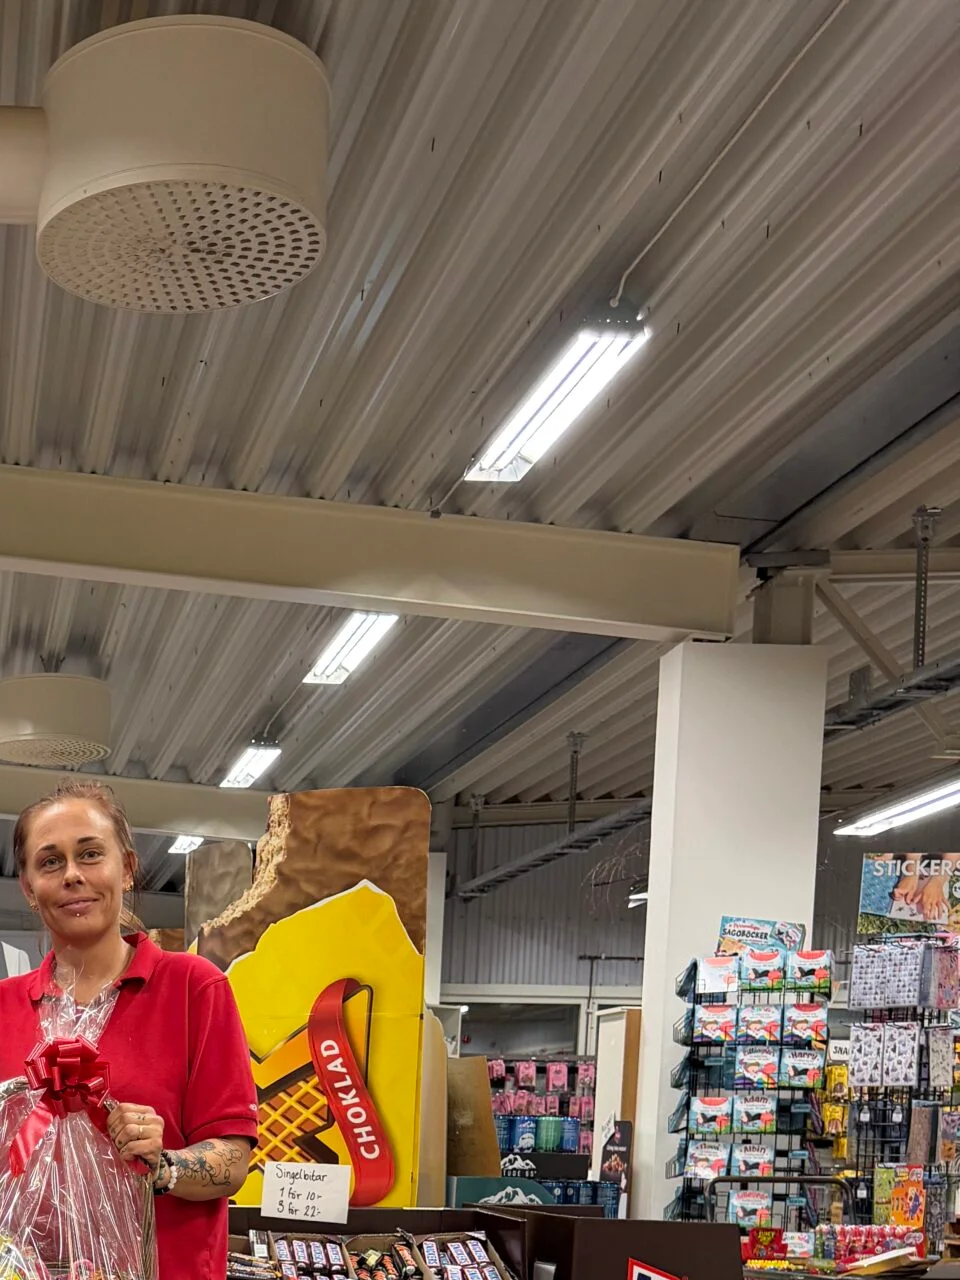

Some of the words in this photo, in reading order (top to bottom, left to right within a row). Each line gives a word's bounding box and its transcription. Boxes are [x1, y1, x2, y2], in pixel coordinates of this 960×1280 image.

[721, 928, 769, 941] SAGOBÖCKER
[790, 1051, 818, 1060] Harry
[320, 1039, 381, 1161] CHOKLAD
[743, 1096, 769, 1105] Adam
[743, 1145, 767, 1154] Albin
[275, 1163, 328, 1186] Singelbitar
[279, 1186, 285, 1198] 1
[287, 1186, 302, 1200] för
[276, 1200, 285, 1214] 3
[288, 1201, 300, 1216] för
